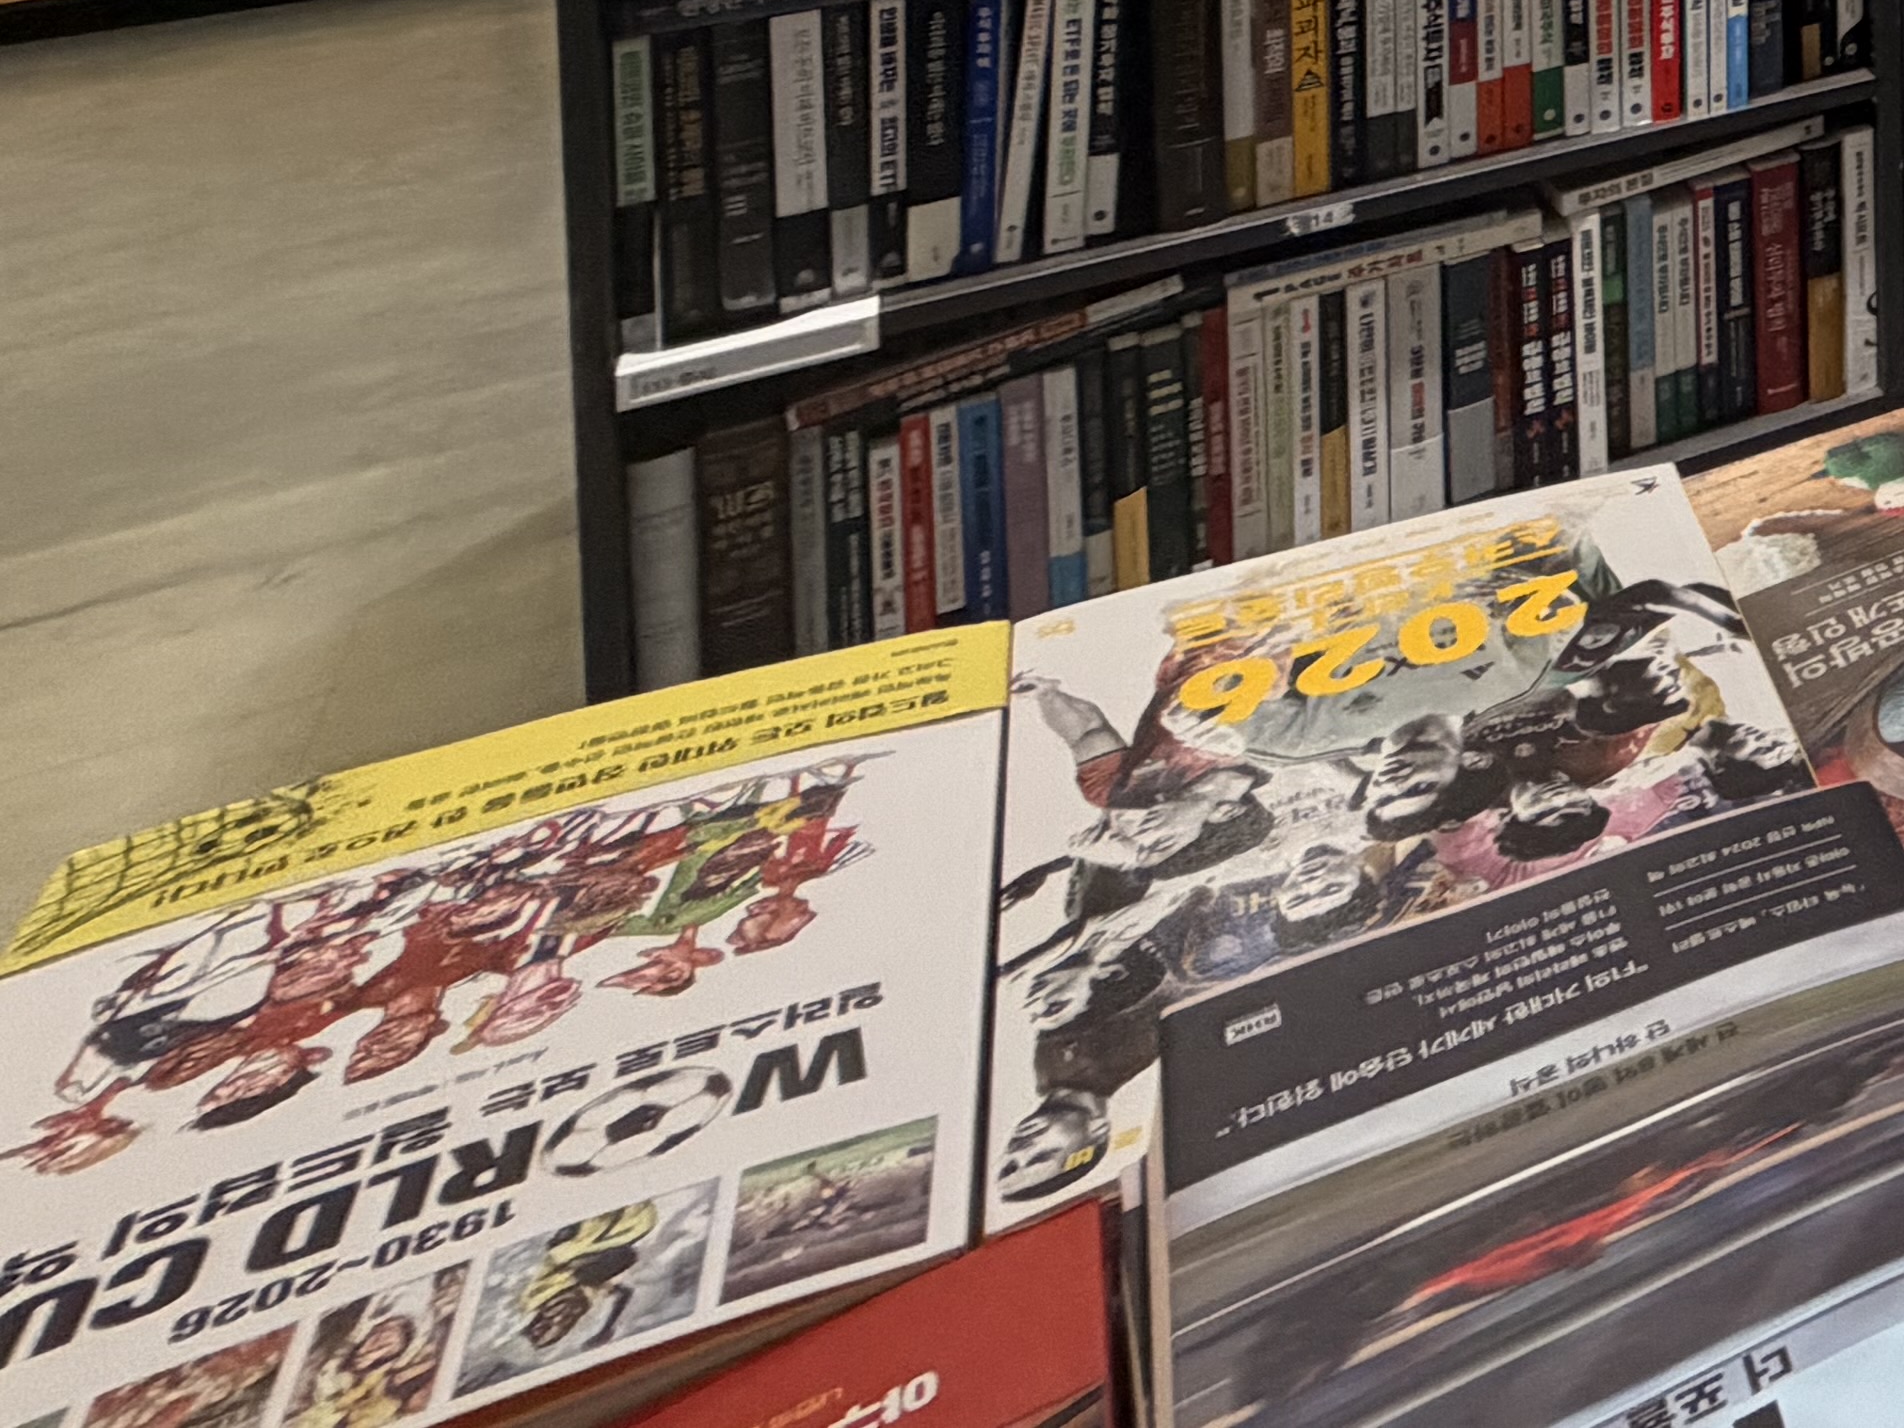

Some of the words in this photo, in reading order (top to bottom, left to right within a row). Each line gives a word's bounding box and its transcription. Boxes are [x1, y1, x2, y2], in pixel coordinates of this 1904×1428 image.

[1168, 568, 1592, 727] 2026
[1770, 617, 1847, 661] 인형
[621, 981, 886, 1058] 일러스트로
[1501, 976, 1581, 1025] 거대한
[480, 1061, 587, 1120] 보는
[109, 1113, 455, 1257] 월드컵의
[169, 1198, 518, 1348] 1930~2026
